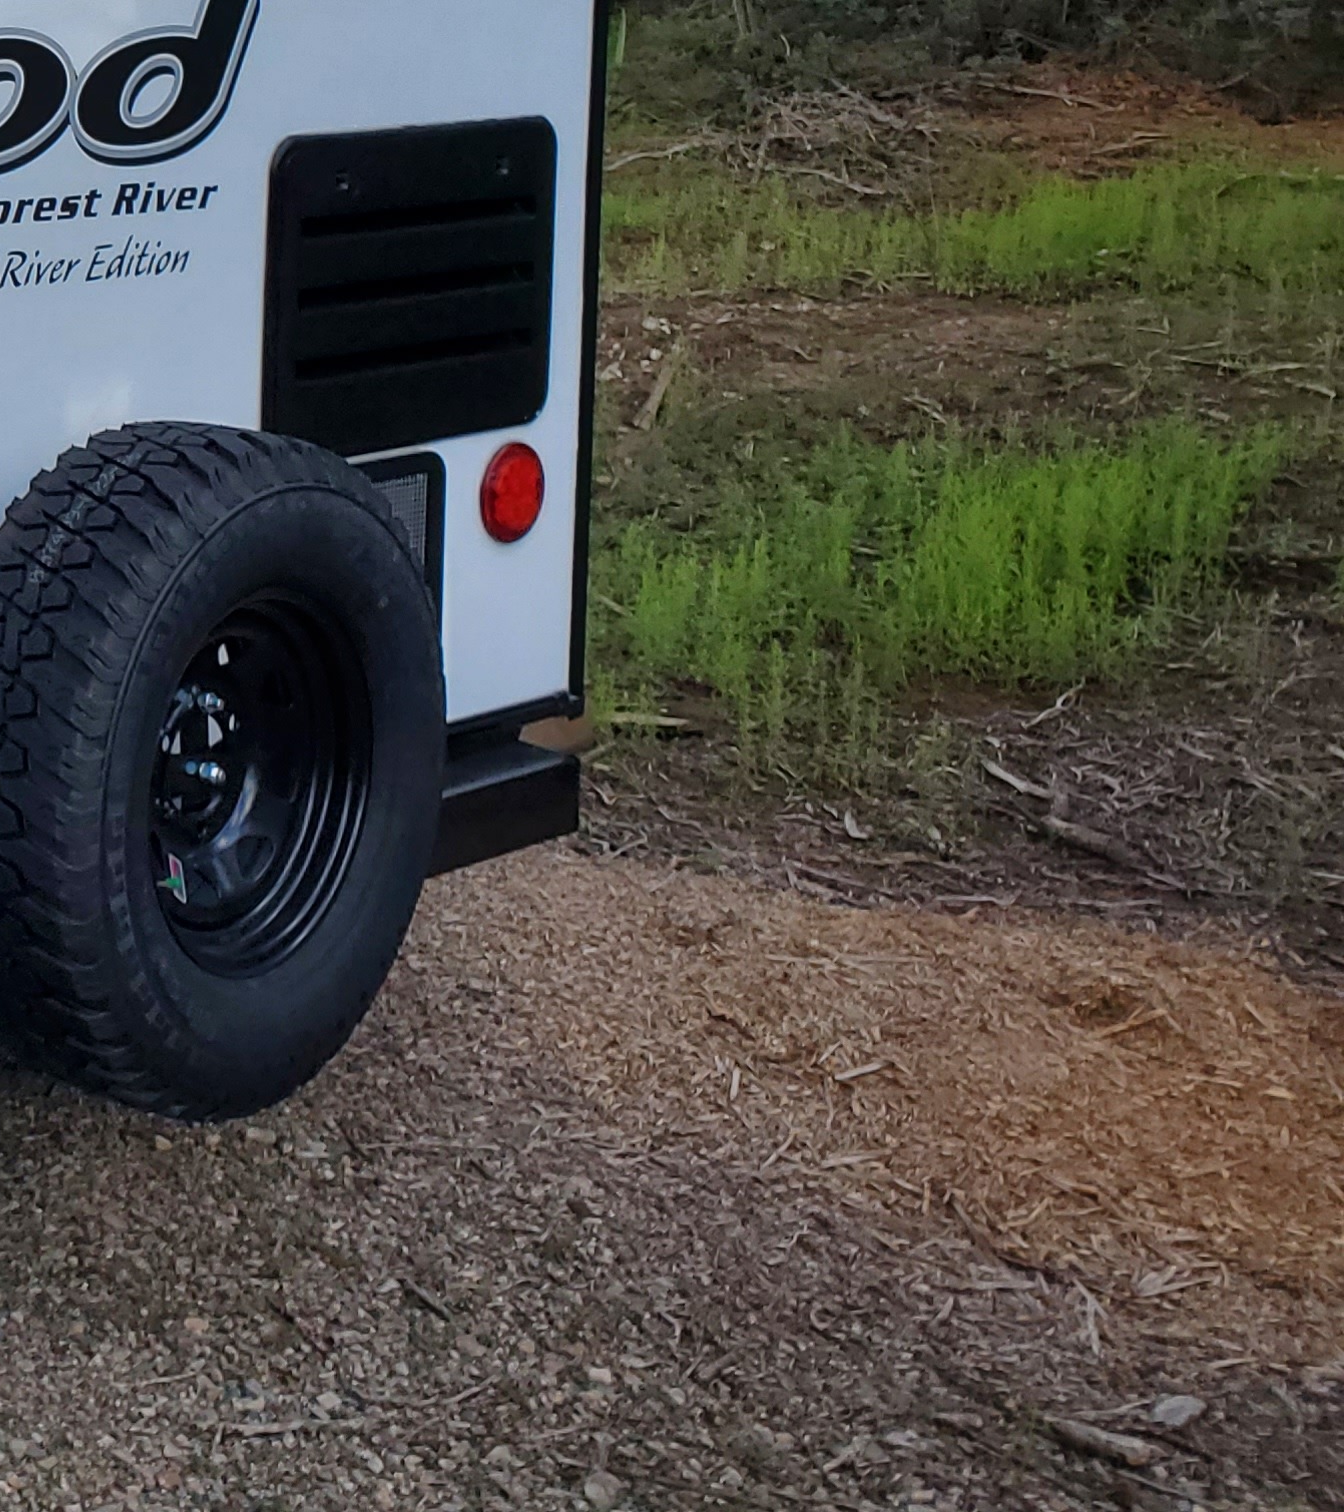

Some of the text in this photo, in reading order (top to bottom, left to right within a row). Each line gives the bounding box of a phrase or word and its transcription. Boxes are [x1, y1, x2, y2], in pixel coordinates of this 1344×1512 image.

[112, 181, 219, 217] River
[0, 249, 82, 289] River
[85, 234, 191, 283] Edition
